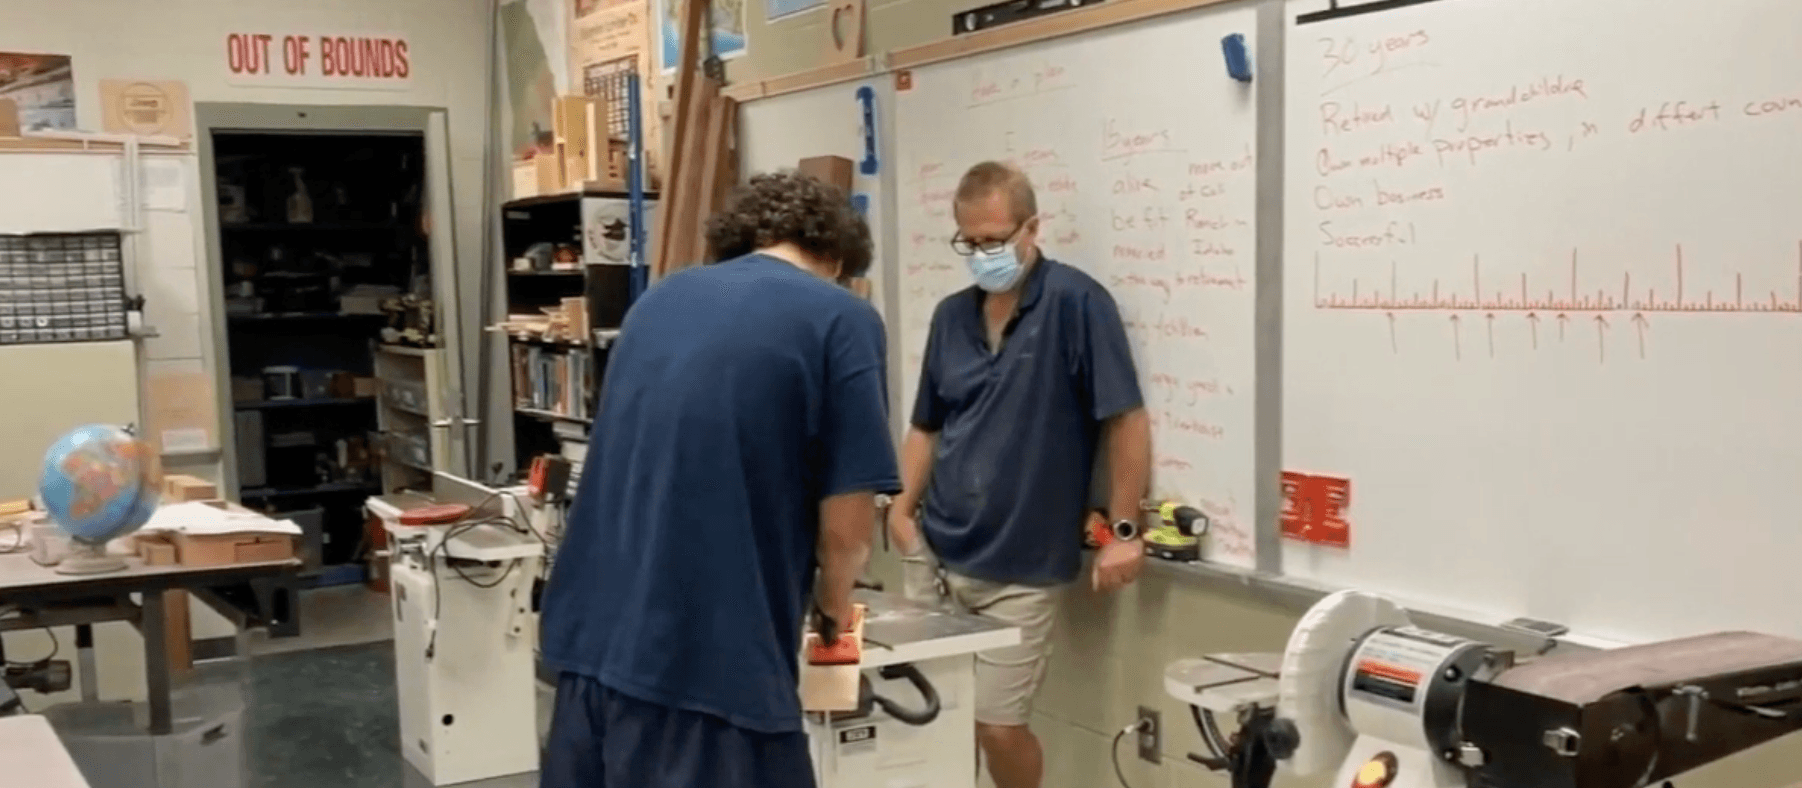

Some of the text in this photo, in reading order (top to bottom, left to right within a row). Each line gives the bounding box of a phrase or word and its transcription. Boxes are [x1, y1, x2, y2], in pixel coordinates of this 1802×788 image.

[227, 33, 409, 79] OUT OF BOUNDS
[1367, 29, 1430, 76] years
